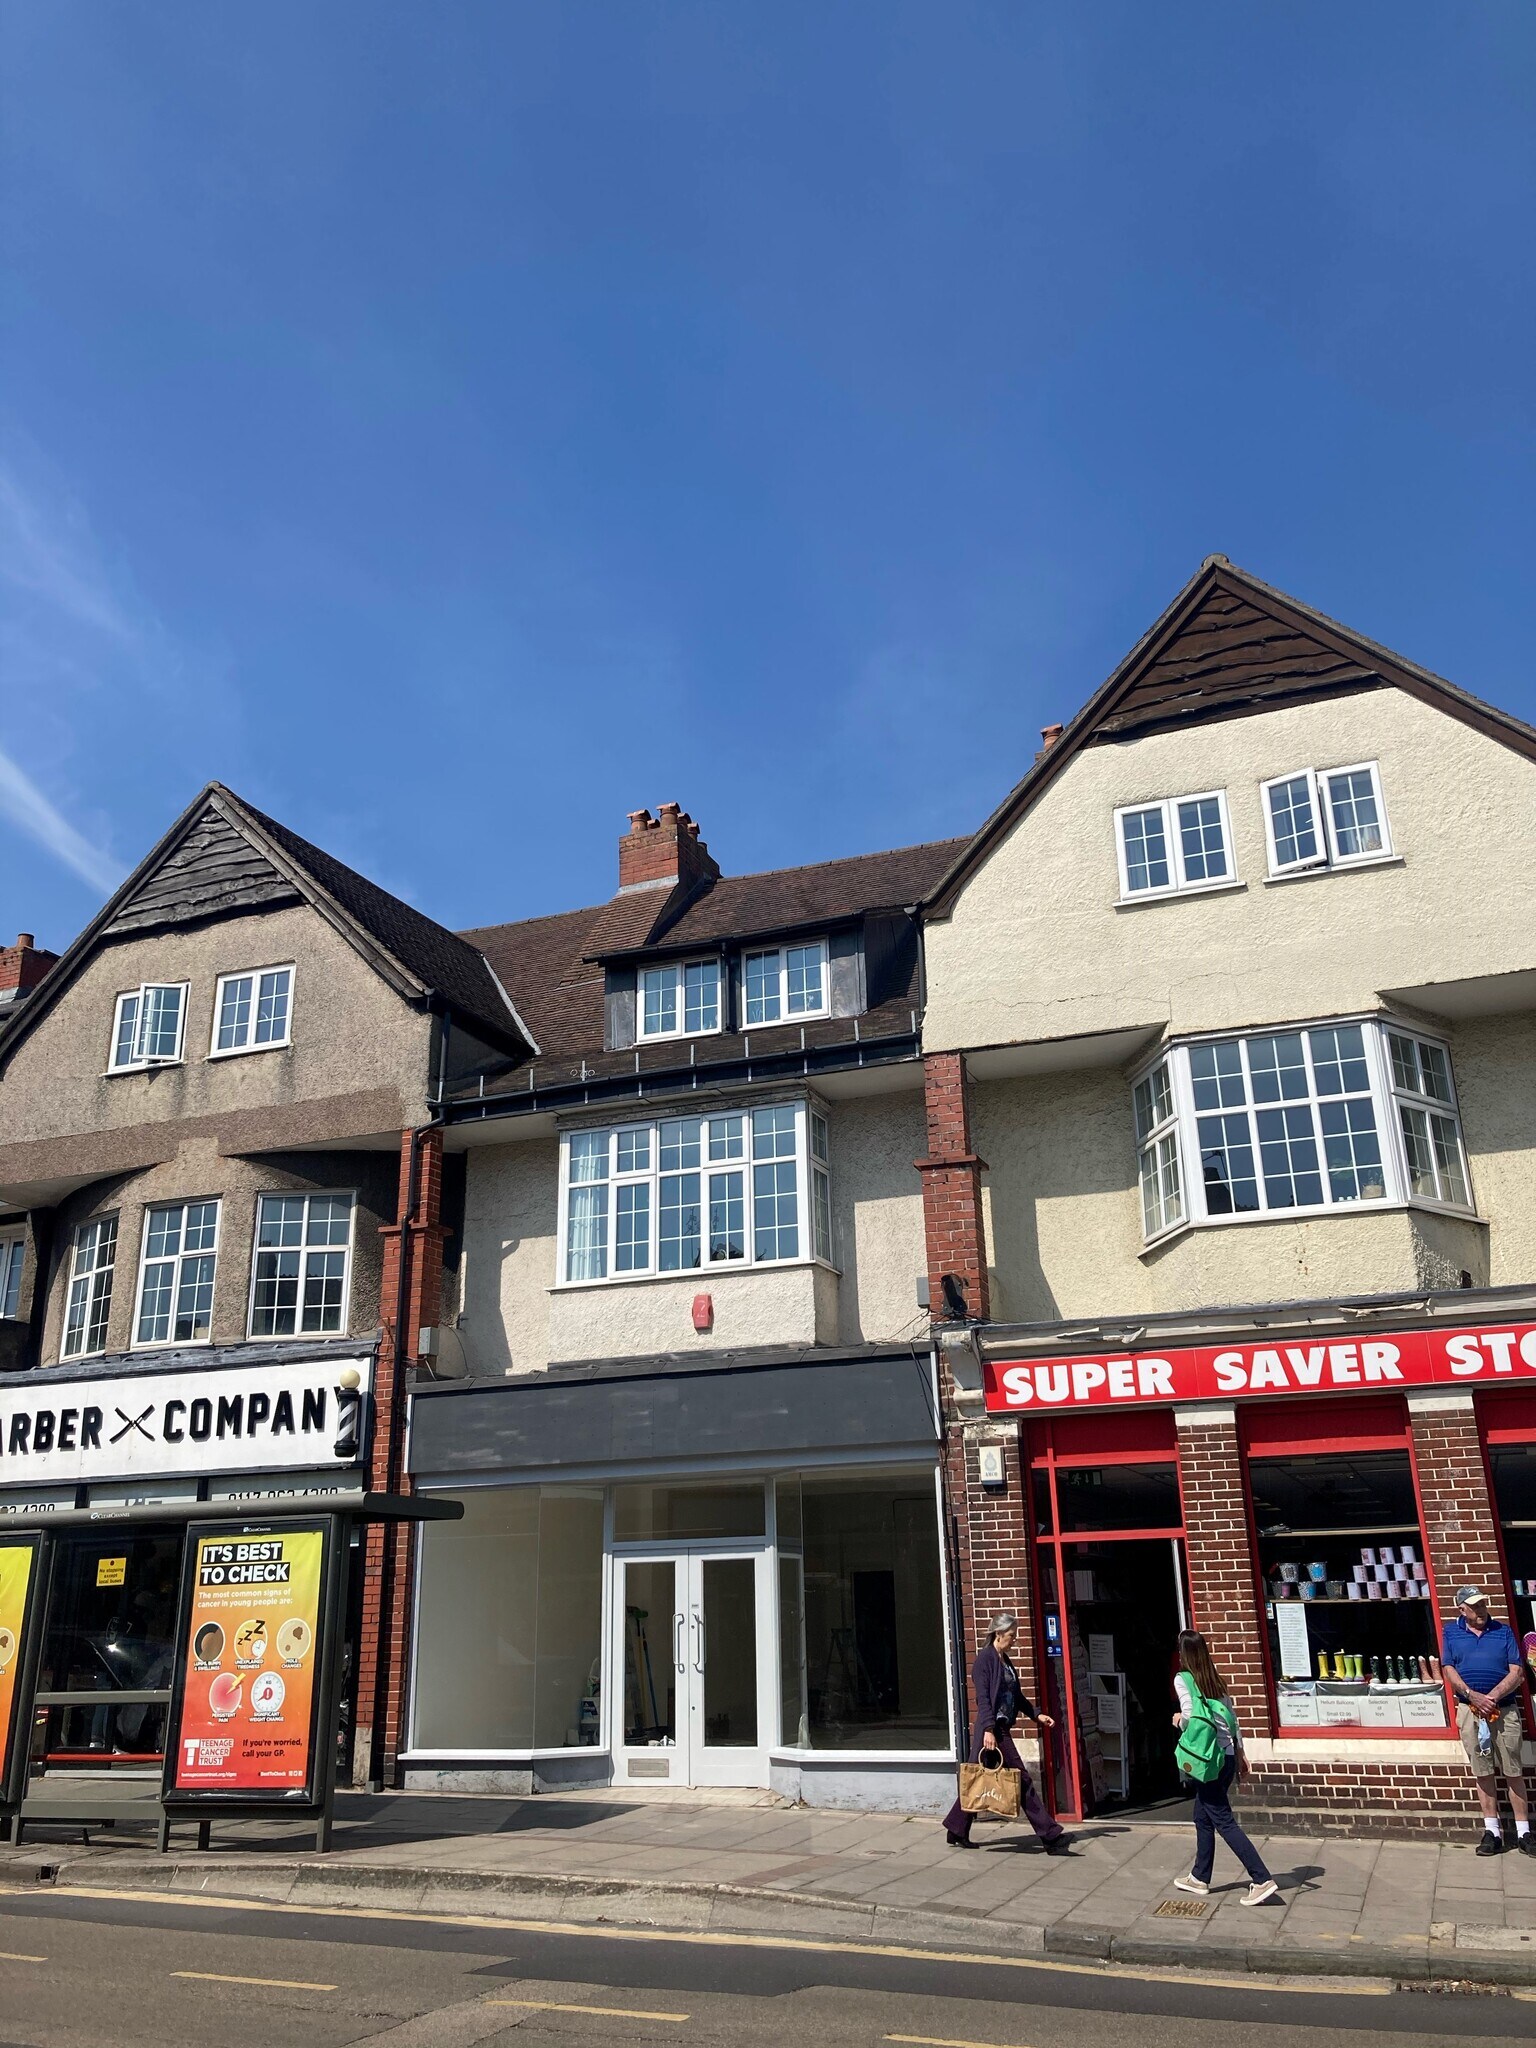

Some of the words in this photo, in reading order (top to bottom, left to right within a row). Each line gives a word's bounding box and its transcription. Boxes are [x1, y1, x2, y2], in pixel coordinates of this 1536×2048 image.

[1002, 1358, 1176, 1405] SUPER
[1212, 1342, 1405, 1391] SAVER
[0, 1406, 103, 1456] RBER
[163, 1386, 341, 1443] COMPAN
[203, 1545, 233, 1563] IT'S
[236, 1542, 282, 1561] BEST
[201, 1566, 225, 1584] TO
[228, 1563, 290, 1584] CHECK
[199, 1591, 211, 1599] The
[212, 1591, 230, 1599] most
[231, 1589, 262, 1598] common
[263, 1588, 282, 1598] signs
[283, 1587, 291, 1596] of
[197, 1600, 220, 1608] cancer
[229, 1599, 251, 1608] young
[253, 1597, 278, 1607] people
[279, 1597, 293, 1605] are:
[201, 1739, 233, 1747] TEENAGE
[250, 1739, 271, 1747] you're
[273, 1738, 303, 1746] worried,
[200, 1748, 229, 1756] CANCER
[256, 1750, 272, 1758] your
[200, 1757, 222, 1765] TRUST
